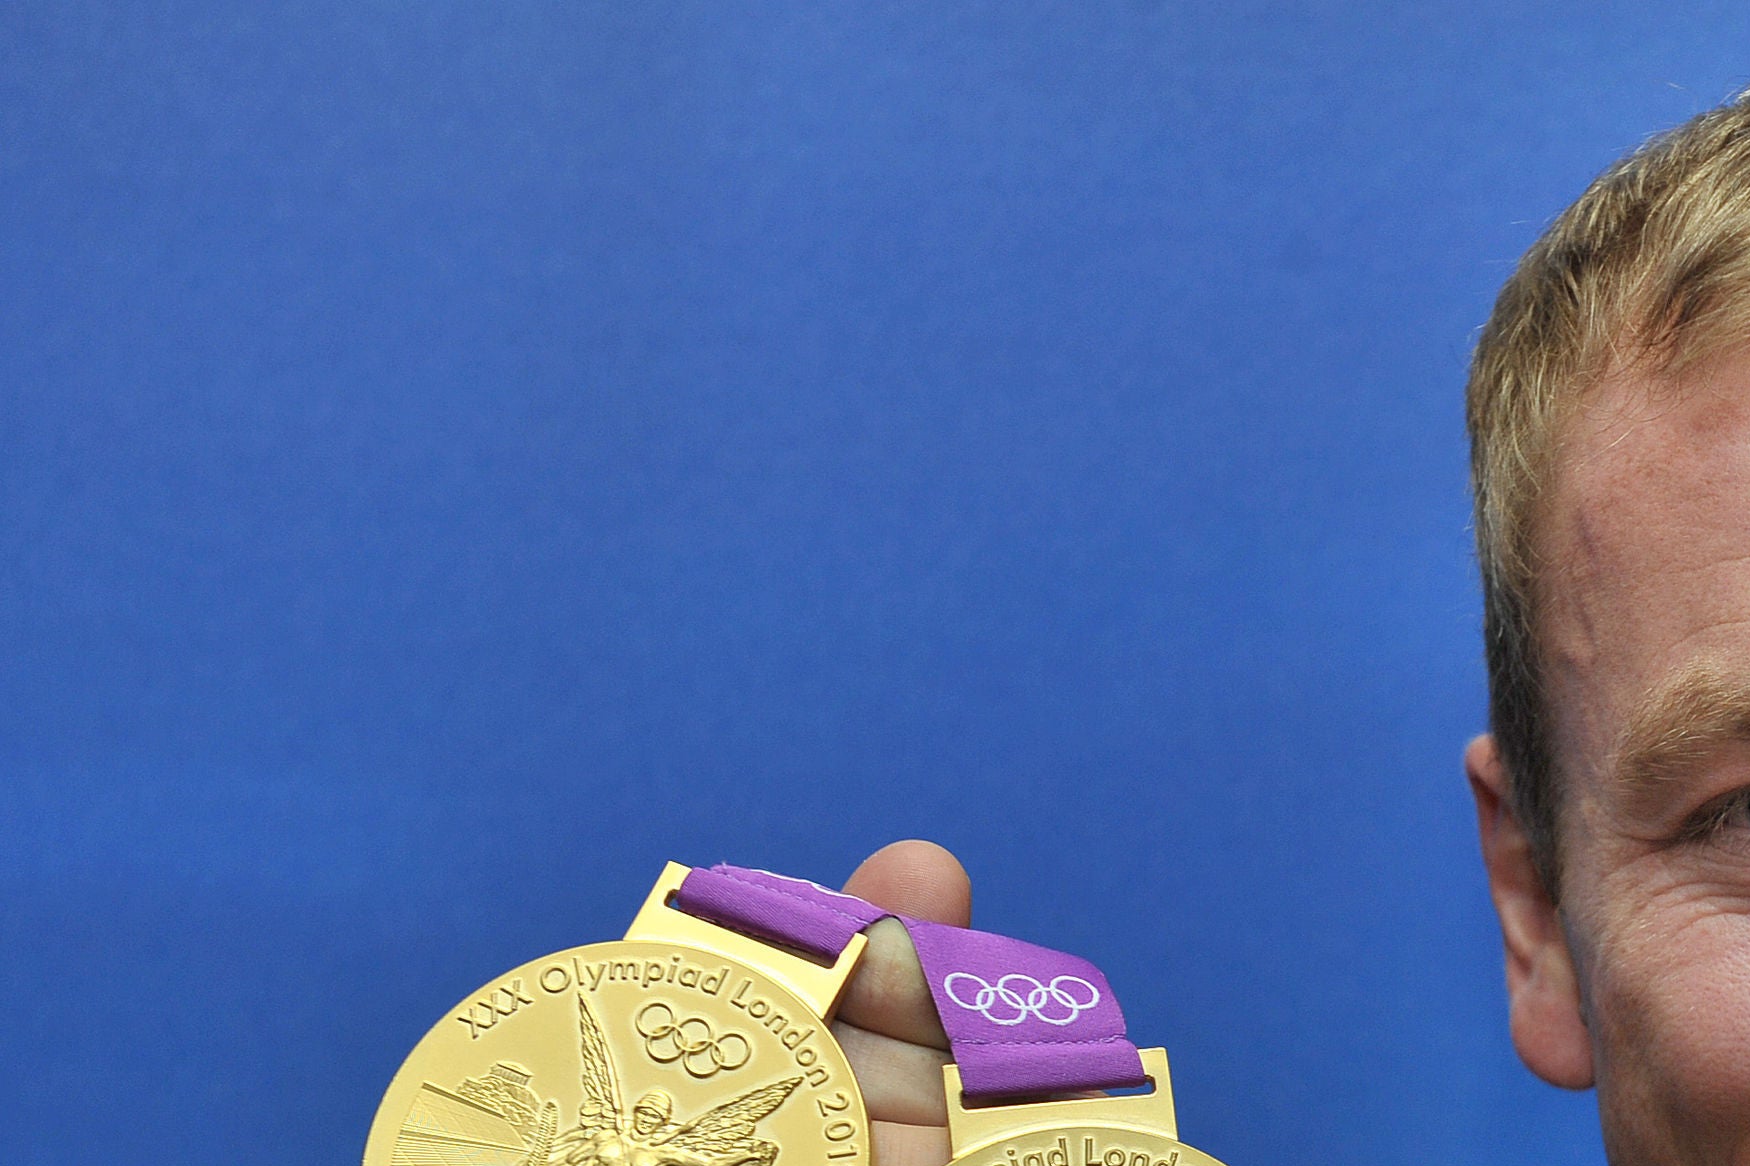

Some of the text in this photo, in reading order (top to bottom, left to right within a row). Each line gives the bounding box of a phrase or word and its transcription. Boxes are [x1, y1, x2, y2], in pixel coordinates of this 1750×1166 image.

[456, 977, 534, 1040] XXX
[540, 955, 730, 997] Olympiad
[731, 980, 830, 1089] London
